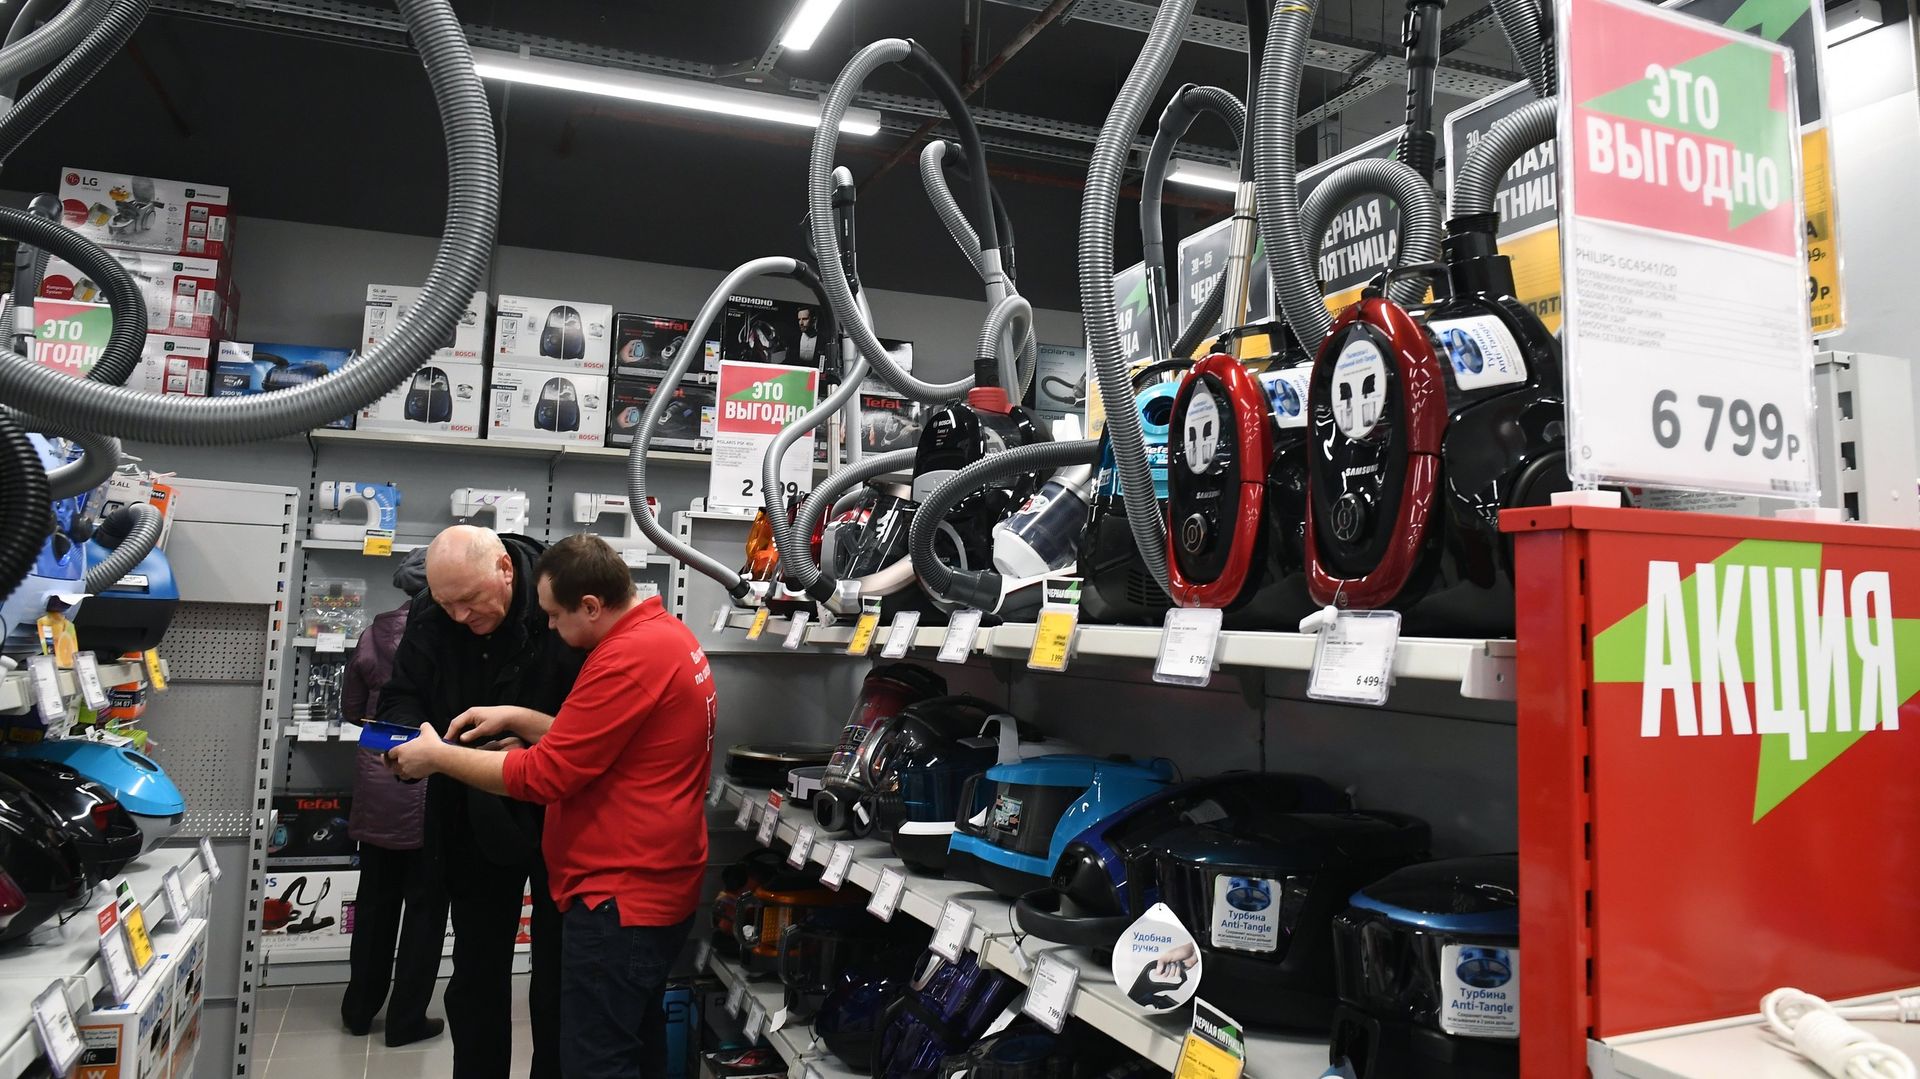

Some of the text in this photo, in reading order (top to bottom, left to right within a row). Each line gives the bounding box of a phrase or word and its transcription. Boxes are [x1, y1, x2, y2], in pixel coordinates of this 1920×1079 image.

[1645, 63, 1719, 130] ЭТО
[1586, 115, 1779, 211] ВЫГОДНО
[82, 176, 98, 187] LG
[1319, 229, 1397, 282] ПЯТНИЦА
[1576, 247, 1616, 268] PHILIPS
[728, 295, 773, 307] REDMOND
[42, 319, 83, 341] ЭТО
[751, 381, 784, 401] ЭТО
[864, 397, 901, 409] Tefal
[1652, 389, 1682, 449] 6
[450, 424, 473, 432] BOSCH
[1345, 463, 1379, 477] SAMSUNG
[1641, 560, 1899, 760] АКЦИЯ
[1363, 676, 1380, 687] 499
[296, 798, 341, 810] Tefal
[1228, 910, 1266, 922] Турбина
[1220, 919, 1272, 934] Anti-Tangle
[1133, 931, 1172, 944] Удобная
[1132, 944, 1159, 954] ручка
[1460, 987, 1506, 1001] Турбина
[1451, 999, 1514, 1015] Anti-Tangle
[1194, 1014, 1218, 1039] ЧЕРНАЯ
